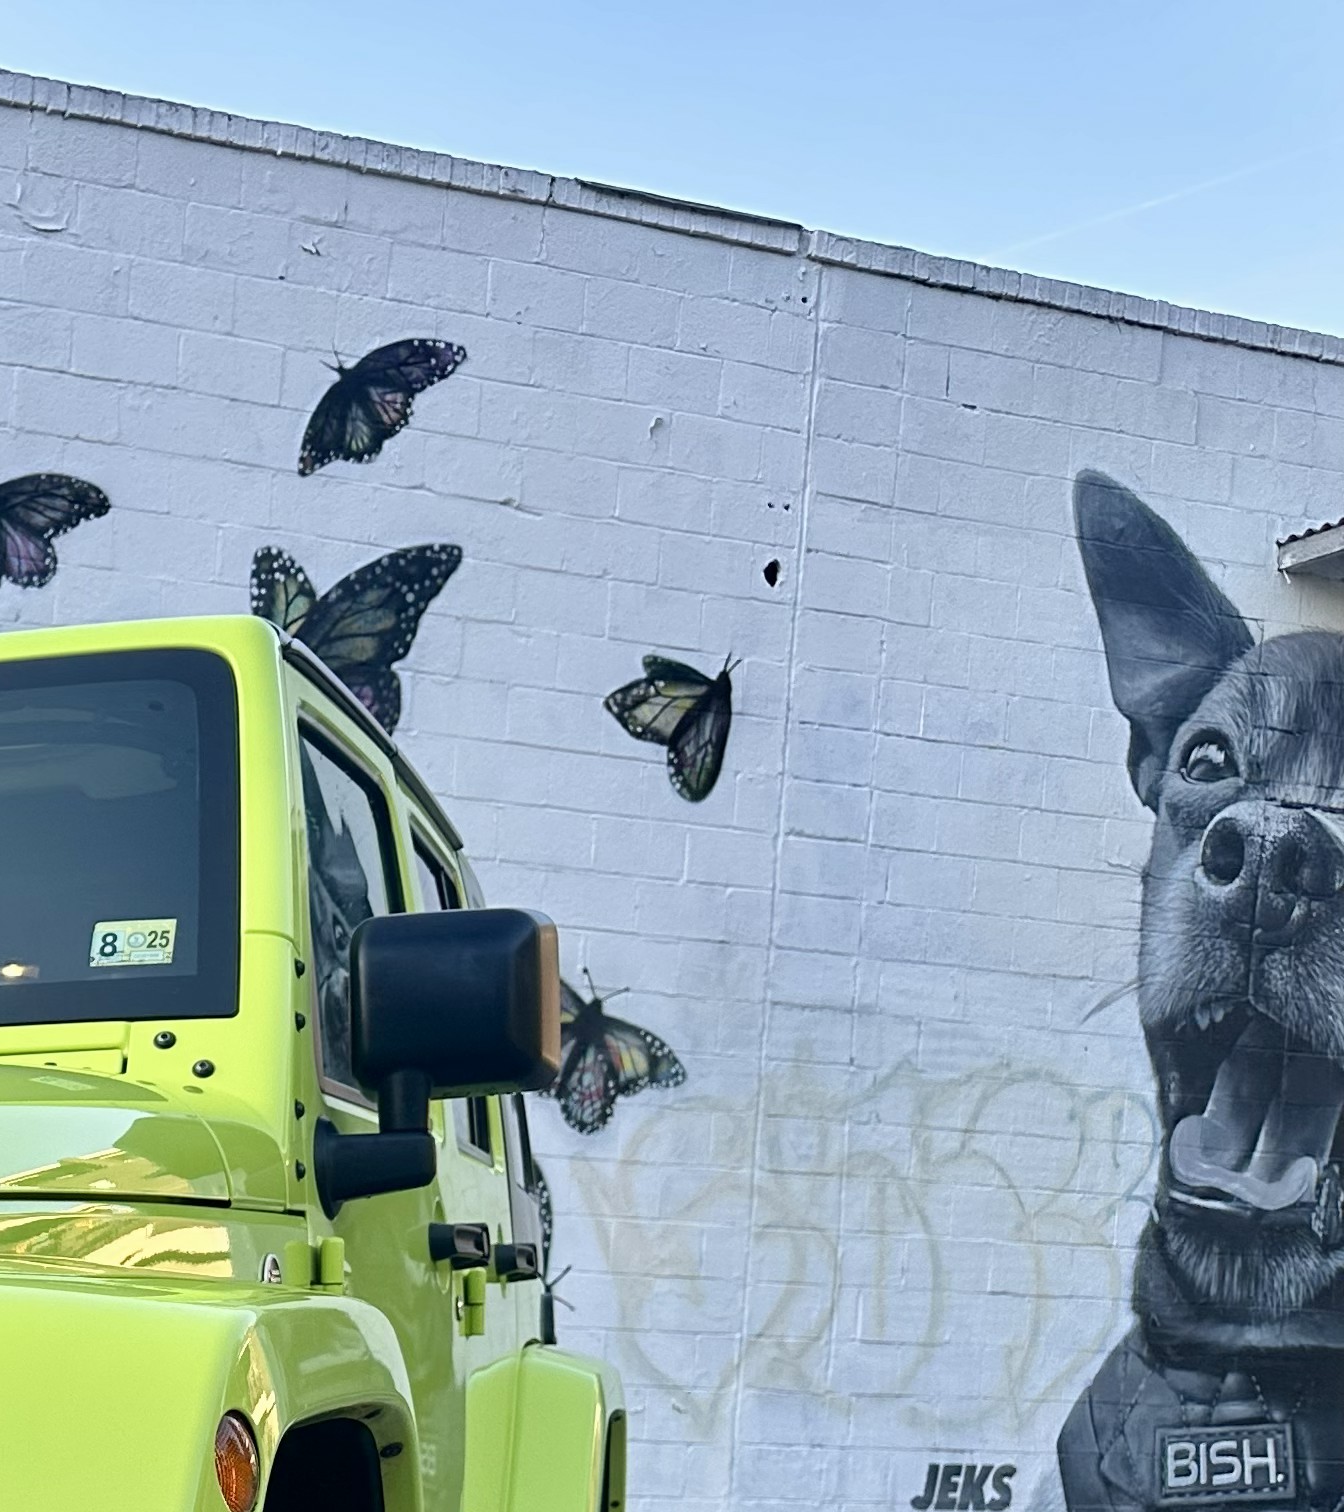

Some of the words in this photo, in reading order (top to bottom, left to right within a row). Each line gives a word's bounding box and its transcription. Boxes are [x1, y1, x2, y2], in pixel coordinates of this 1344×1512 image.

[99, 932, 118, 957] 8
[146, 930, 170, 948] 25
[1167, 1438, 1285, 1487] BISH.
[910, 1464, 1017, 1511] JEKS
